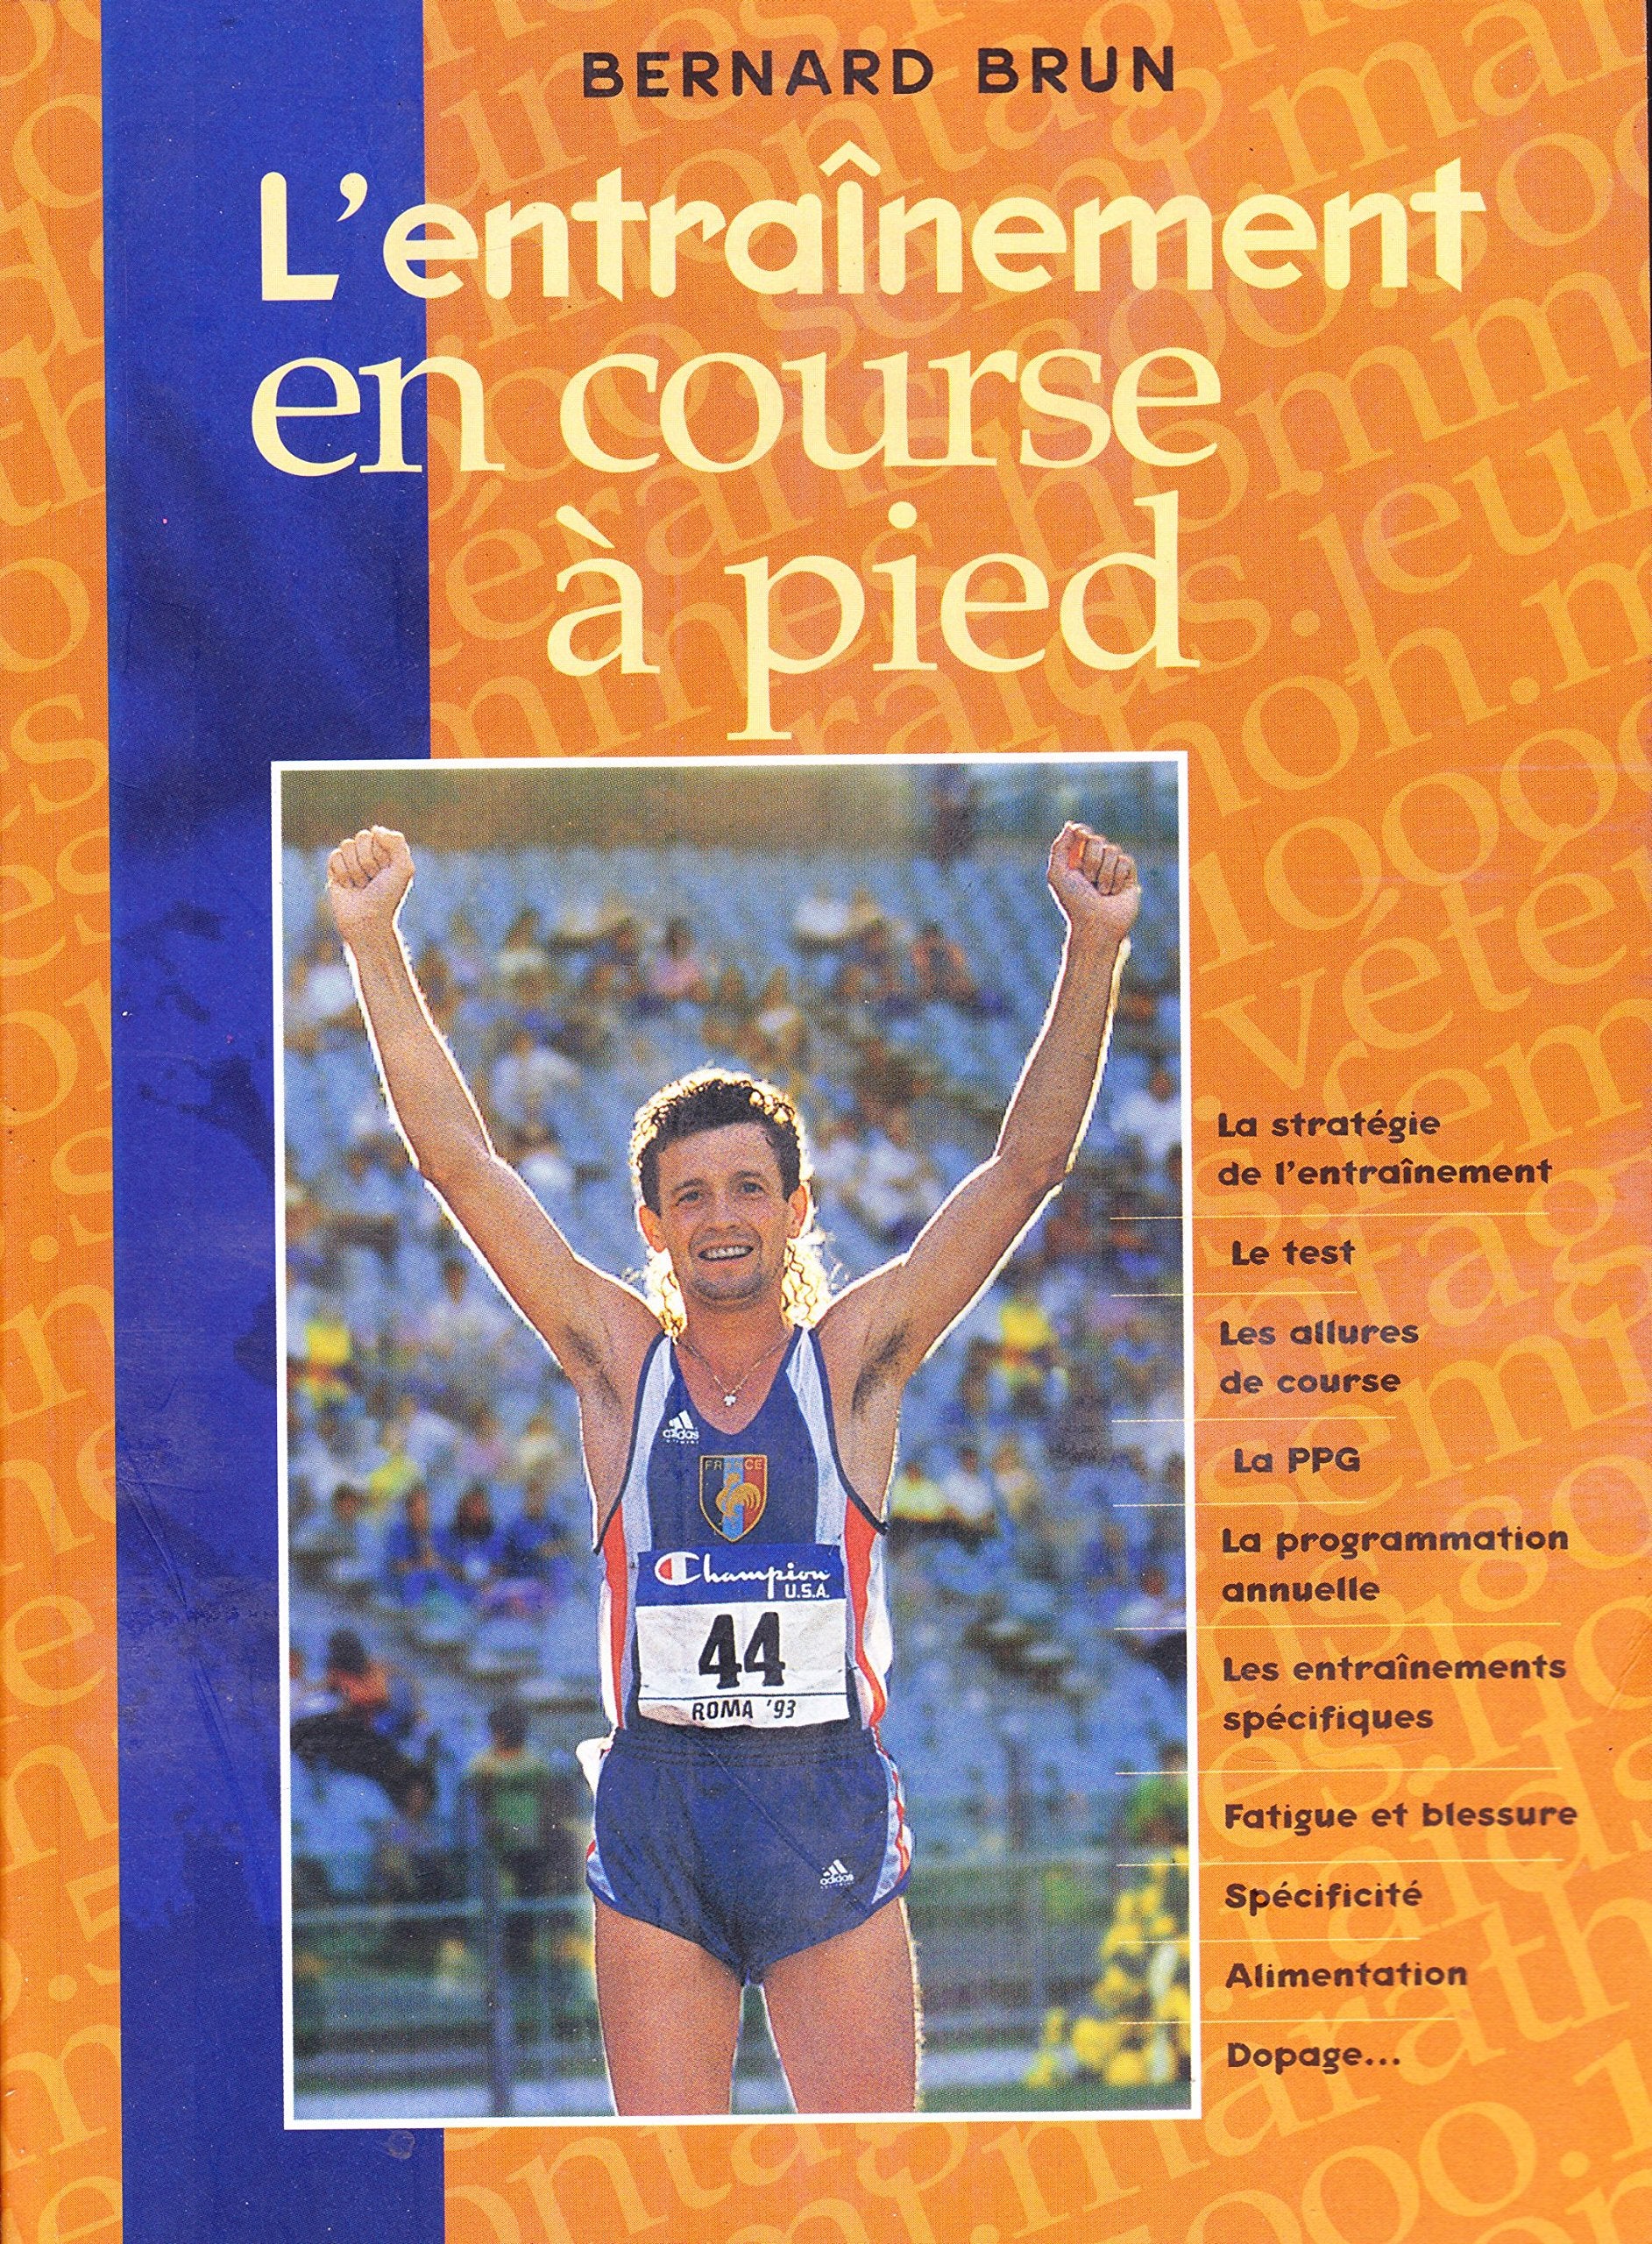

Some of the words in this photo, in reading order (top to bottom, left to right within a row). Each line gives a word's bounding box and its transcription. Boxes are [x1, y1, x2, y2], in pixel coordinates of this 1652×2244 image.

[583, 48, 934, 98] BERNARD
[978, 46, 1175, 94] BRUN
[251, 354, 506, 478] en
[558, 349, 1223, 474] course
[547, 505, 662, 678] à
[724, 489, 1202, 741] pied
[1218, 1112, 1258, 1138] La
[1272, 1109, 1441, 1144] stratégie
[1218, 1161, 1262, 1186] de
[1231, 1240, 1270, 1266] Le
[1282, 1239, 1356, 1266] test
[1220, 1321, 1276, 1346] Les
[1290, 1320, 1419, 1346] allures
[1219, 1370, 1264, 1395] de
[1277, 1373, 1401, 1395] course
[1234, 1448, 1273, 1474] La
[1288, 1446, 1360, 1474] PPG
[1222, 1528, 1261, 1553] La
[1276, 1527, 1568, 1561] programmation
[655, 1551, 831, 1600] Champion
[784, 1582, 831, 1599] U.S.A.
[1222, 1576, 1380, 1602] annuelle
[698, 1611, 786, 1690] 44
[1223, 1657, 1280, 1682] Les
[1294, 1653, 1566, 1681] entraînements
[691, 1699, 755, 1721] ROMA
[1223, 1705, 1433, 1739] spécifiques
[1225, 1804, 1358, 1836] Fatigue
[1372, 1803, 1407, 1827] et
[1423, 1803, 1578, 1827] blessure
[1225, 1883, 1422, 1917] Spécificité
[1225, 1963, 1466, 1989] Alimentation
